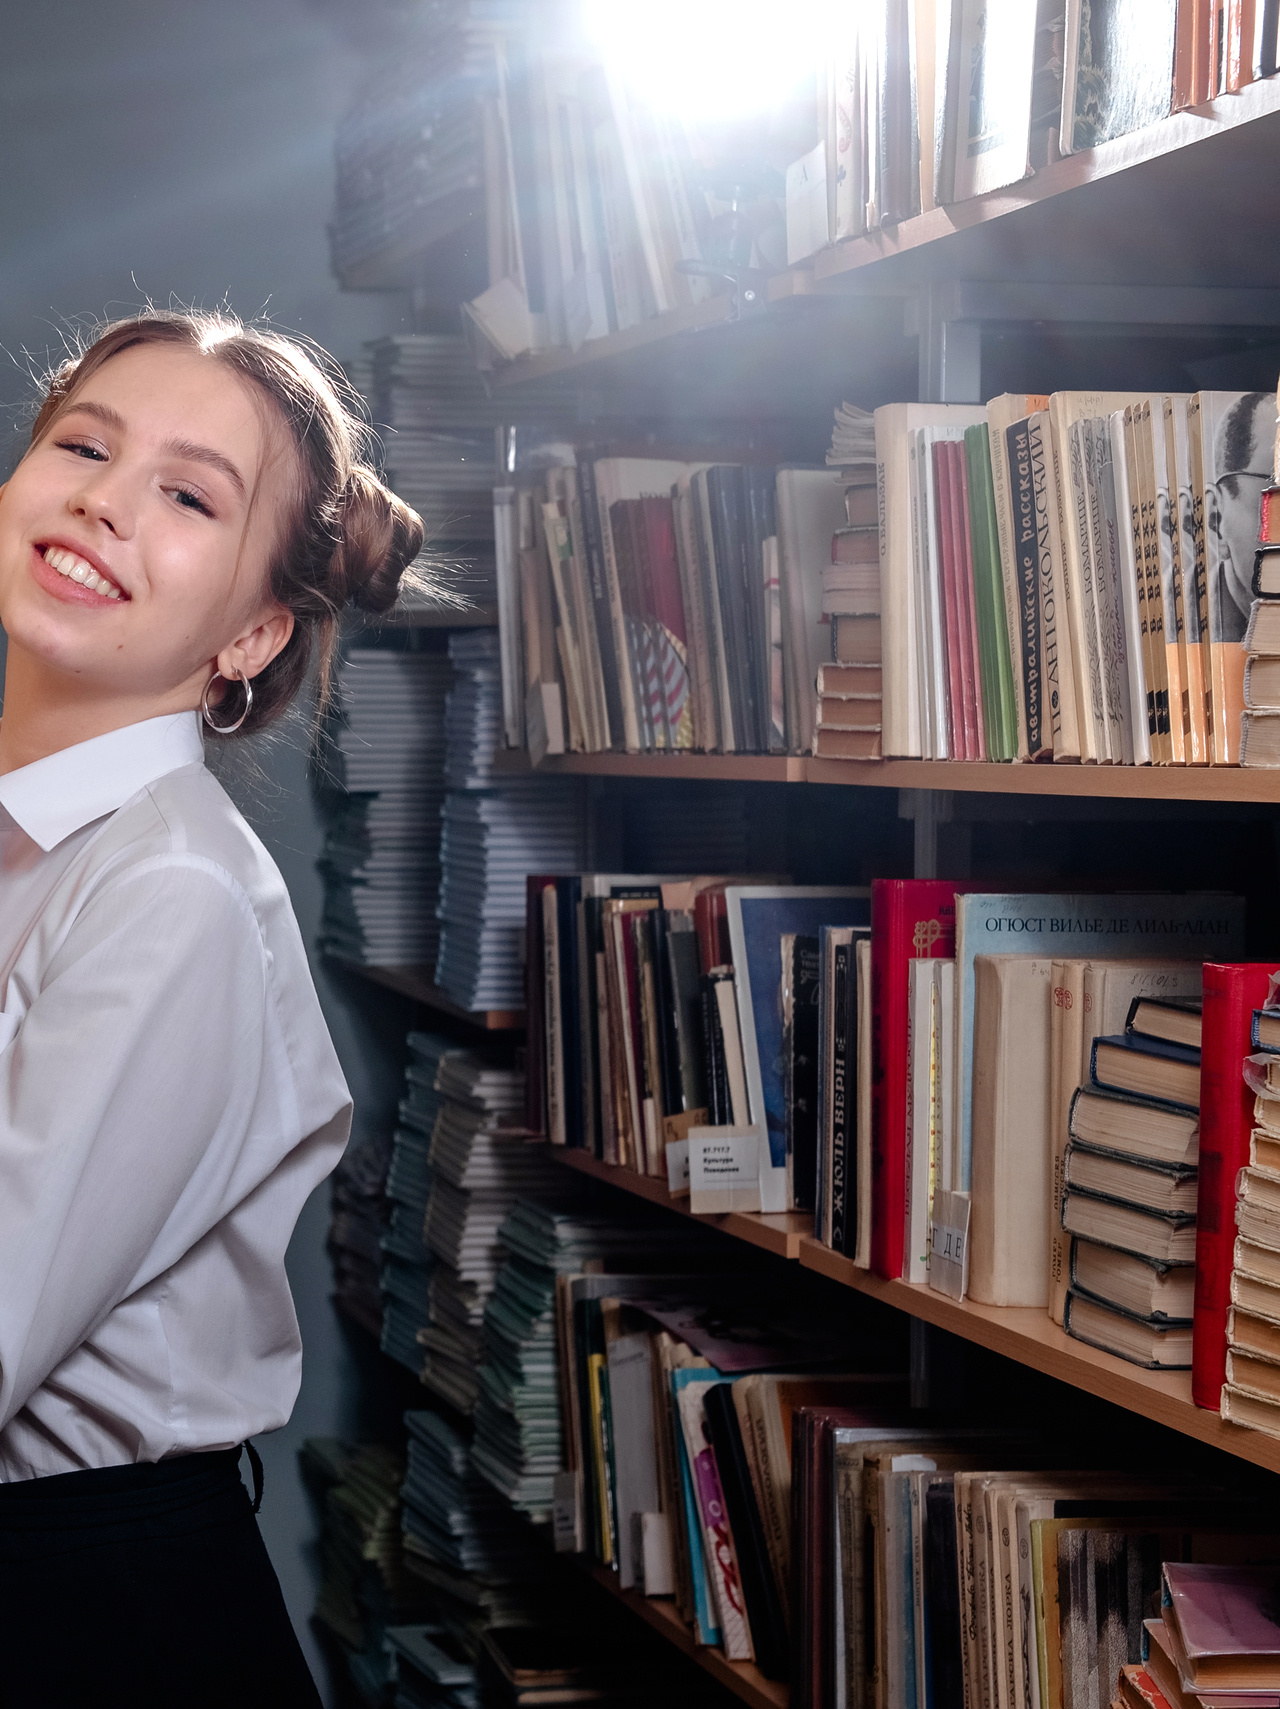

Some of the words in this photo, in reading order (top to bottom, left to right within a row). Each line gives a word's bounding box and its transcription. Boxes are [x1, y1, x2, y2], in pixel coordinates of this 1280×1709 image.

[992, 428, 1003, 482] КЛЮЧИКОМ
[997, 483, 1003, 491] С
[1015, 432, 1035, 543] рассказы
[998, 493, 1006, 520] ЧАСЫ
[999, 519, 1011, 584] СЕРЕБРЯНЫЕ
[1029, 424, 1059, 684] АНТОКОЛЬСКИЙ
[1077, 491, 1092, 594] БОМАРШЕ
[1091, 490, 1106, 593] БОМАРШЕ
[1023, 556, 1038, 742] австралийские
[985, 917, 1046, 933] ОГЮСТ
[1049, 917, 1104, 933] ВИЛЬЕ
[1105, 919, 1129, 935] ДЕ
[1130, 919, 1229, 935] ЛИЛЬ-АДАН
[834, 1057, 845, 1126] ВЕРН
[834, 1131, 844, 1217] ЖЮЛЬ
[978, 1560, 986, 1615] ЛОРКА
[1005, 1573, 1013, 1629] ЛОРКА
[981, 1625, 989, 1693] ГАРСИА
[1007, 1639, 1015, 1707] ГАРСИА
